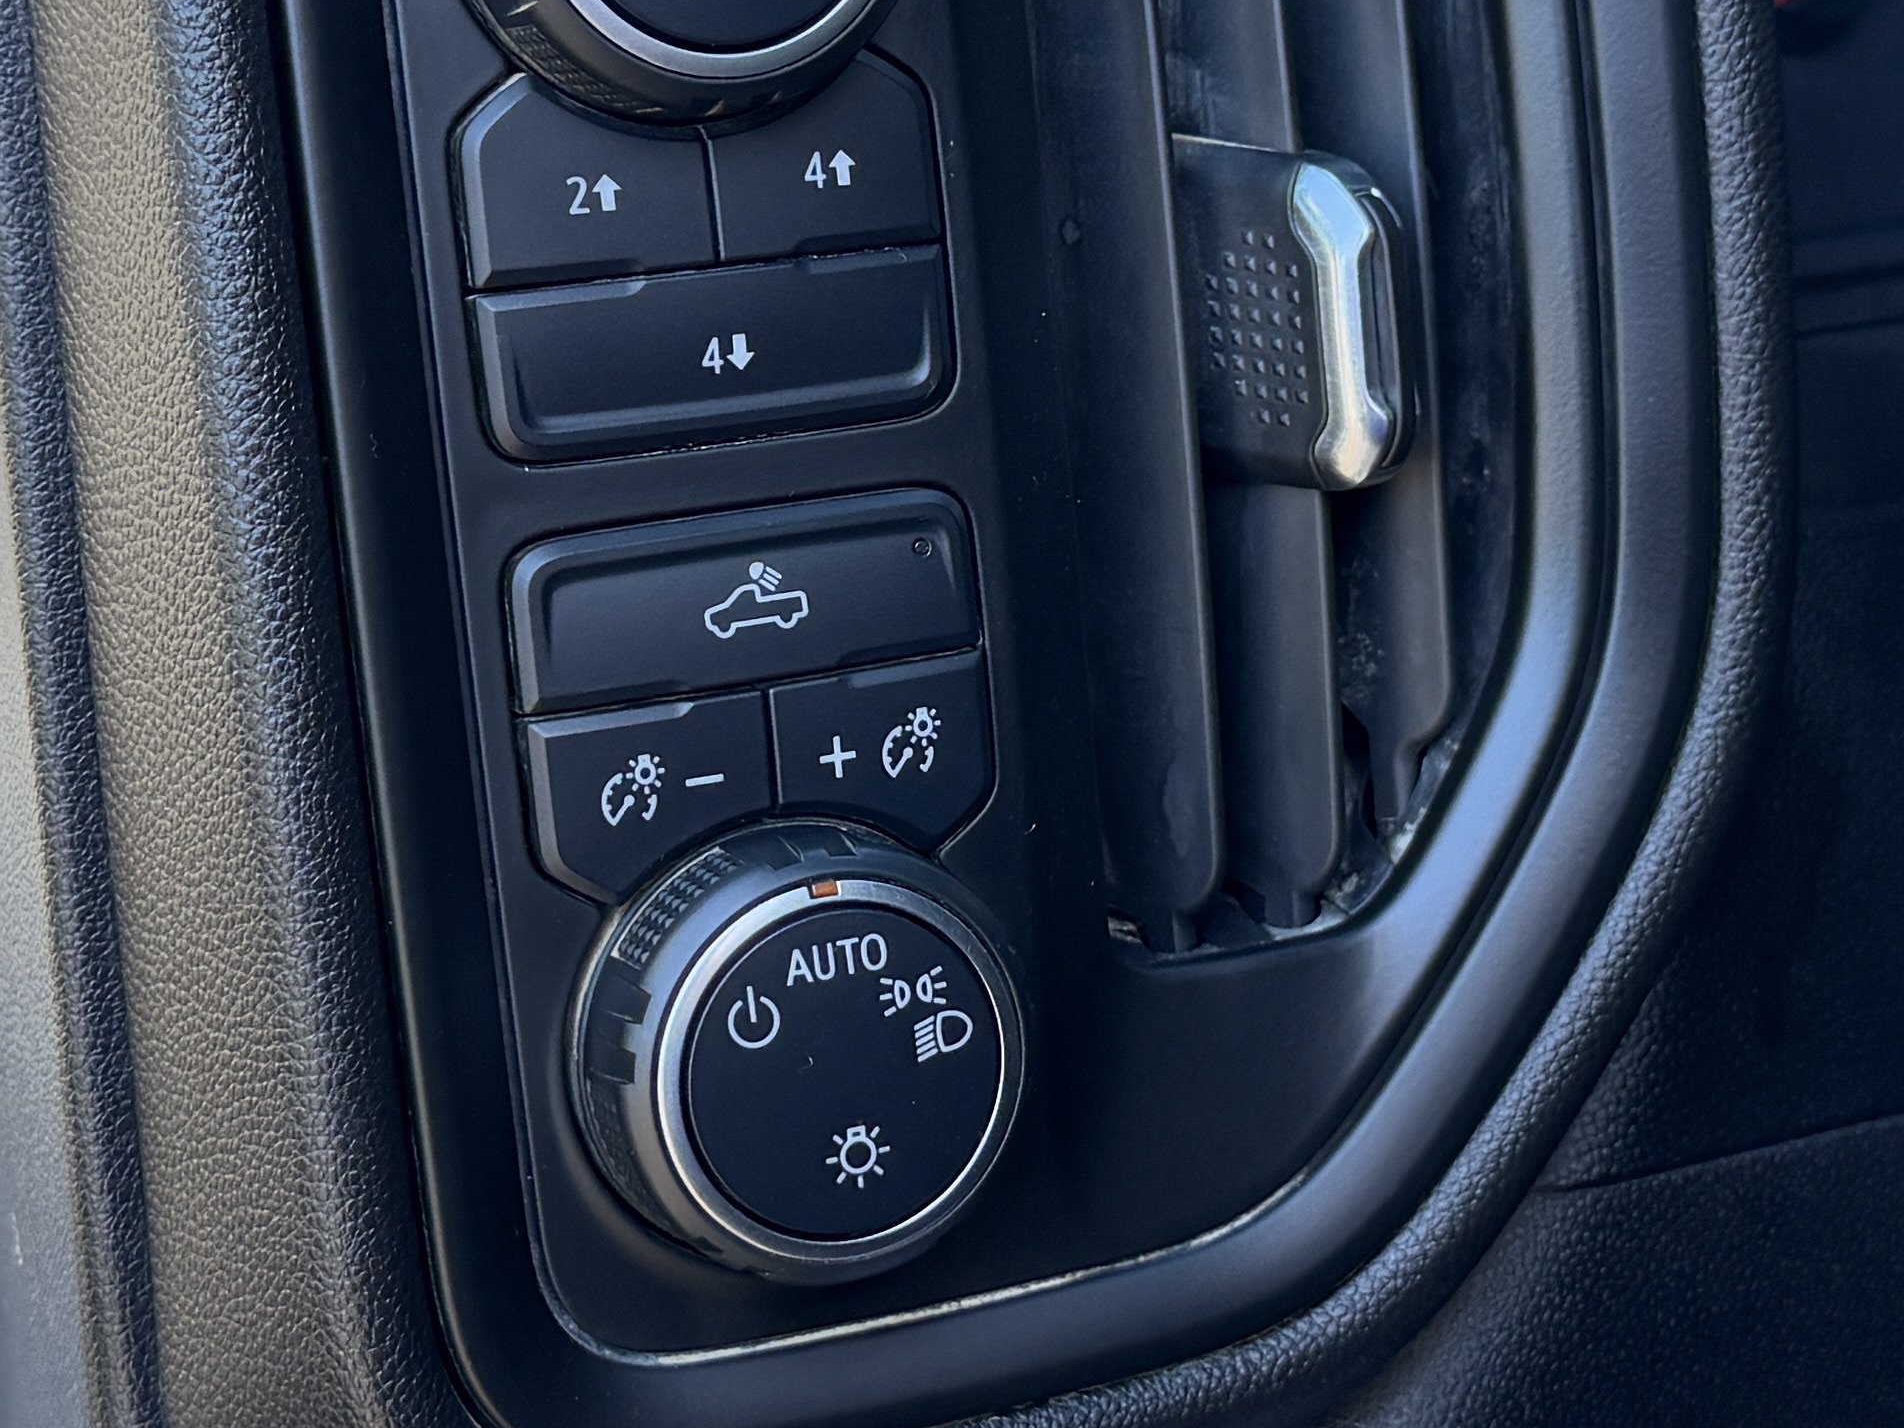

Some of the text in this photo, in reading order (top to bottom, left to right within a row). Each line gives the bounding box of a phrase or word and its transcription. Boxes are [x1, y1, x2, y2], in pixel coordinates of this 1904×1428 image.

[804, 152, 828, 189] 4
[566, 176, 591, 216] 2
[701, 338, 725, 375] 4
[786, 933, 888, 987] AUTO
